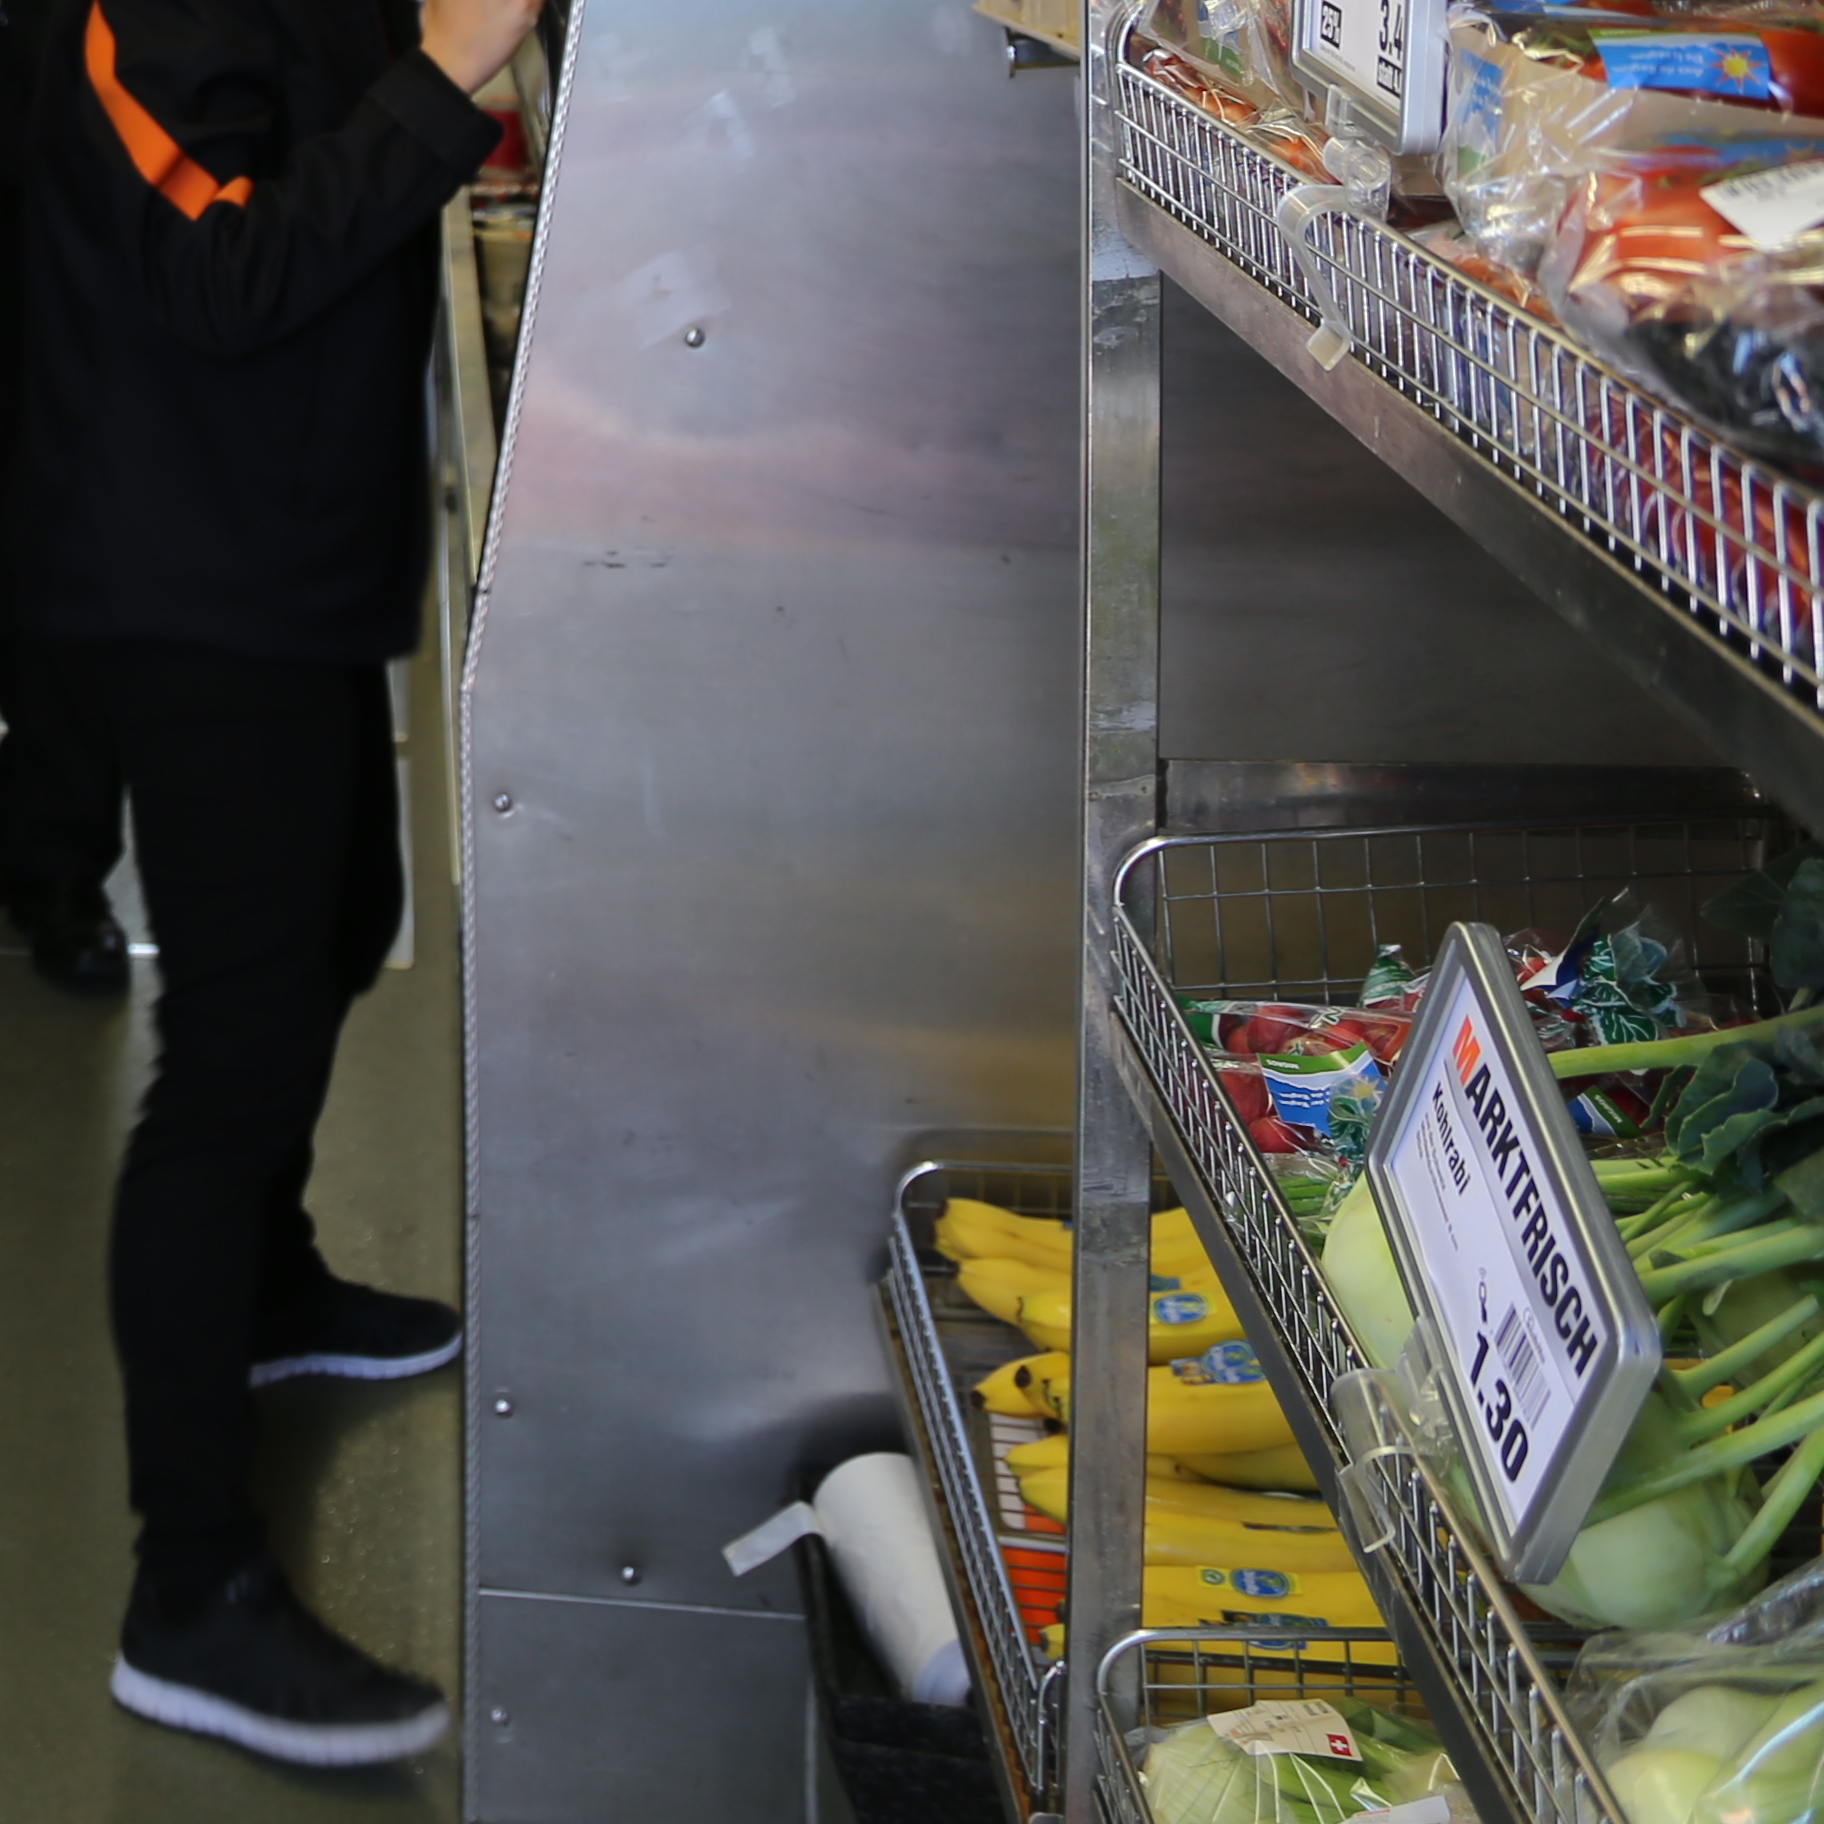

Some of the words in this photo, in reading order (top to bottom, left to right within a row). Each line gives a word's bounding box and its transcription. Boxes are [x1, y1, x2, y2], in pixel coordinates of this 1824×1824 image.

[1322, 5, 1342, 43] 25%
[1431, 1080, 1472, 1197] Kohlrabi
[1451, 1014, 1599, 1380] MARKTFRISCH
[1468, 1331, 1531, 1483] 1.30
